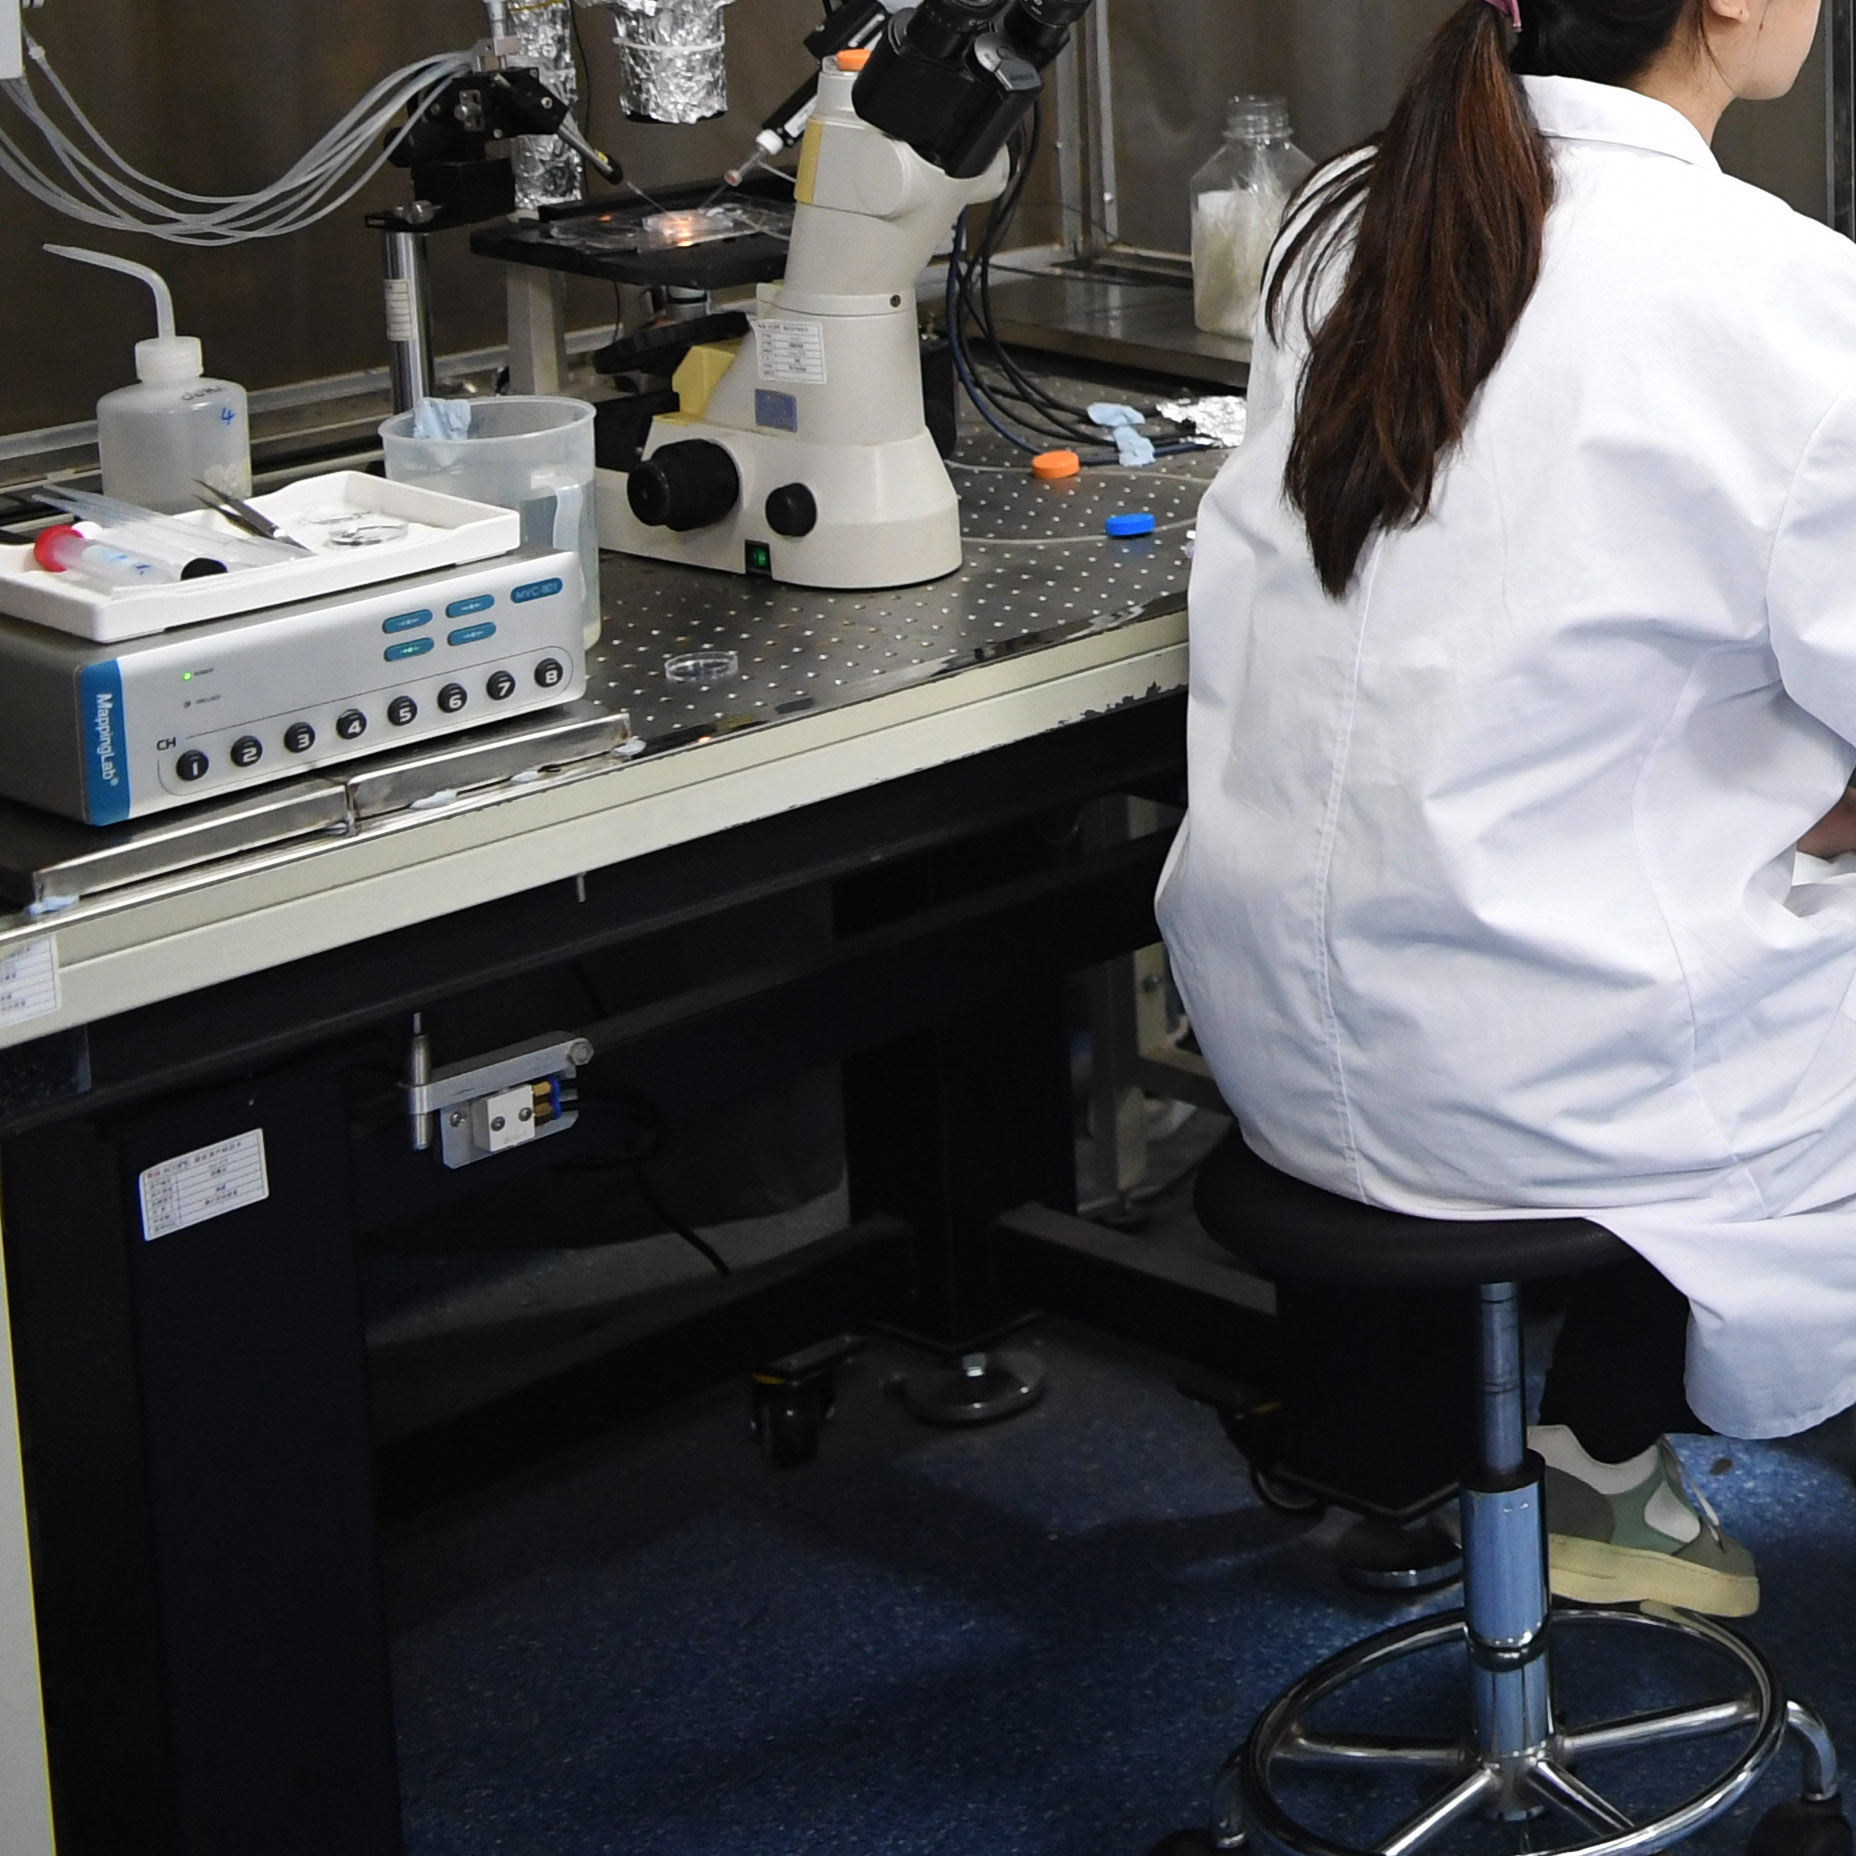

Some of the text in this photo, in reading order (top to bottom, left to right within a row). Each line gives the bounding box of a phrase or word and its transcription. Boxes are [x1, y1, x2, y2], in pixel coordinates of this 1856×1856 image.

[156, 736, 177, 752] CH
[242, 748, 257, 762] 2
[296, 734, 310, 748] 3
[347, 720, 361, 734] 4
[399, 707, 412, 721] 5
[449, 694, 462, 708] 6
[498, 682, 511, 696] 7
[544, 670, 558, 684] 8
